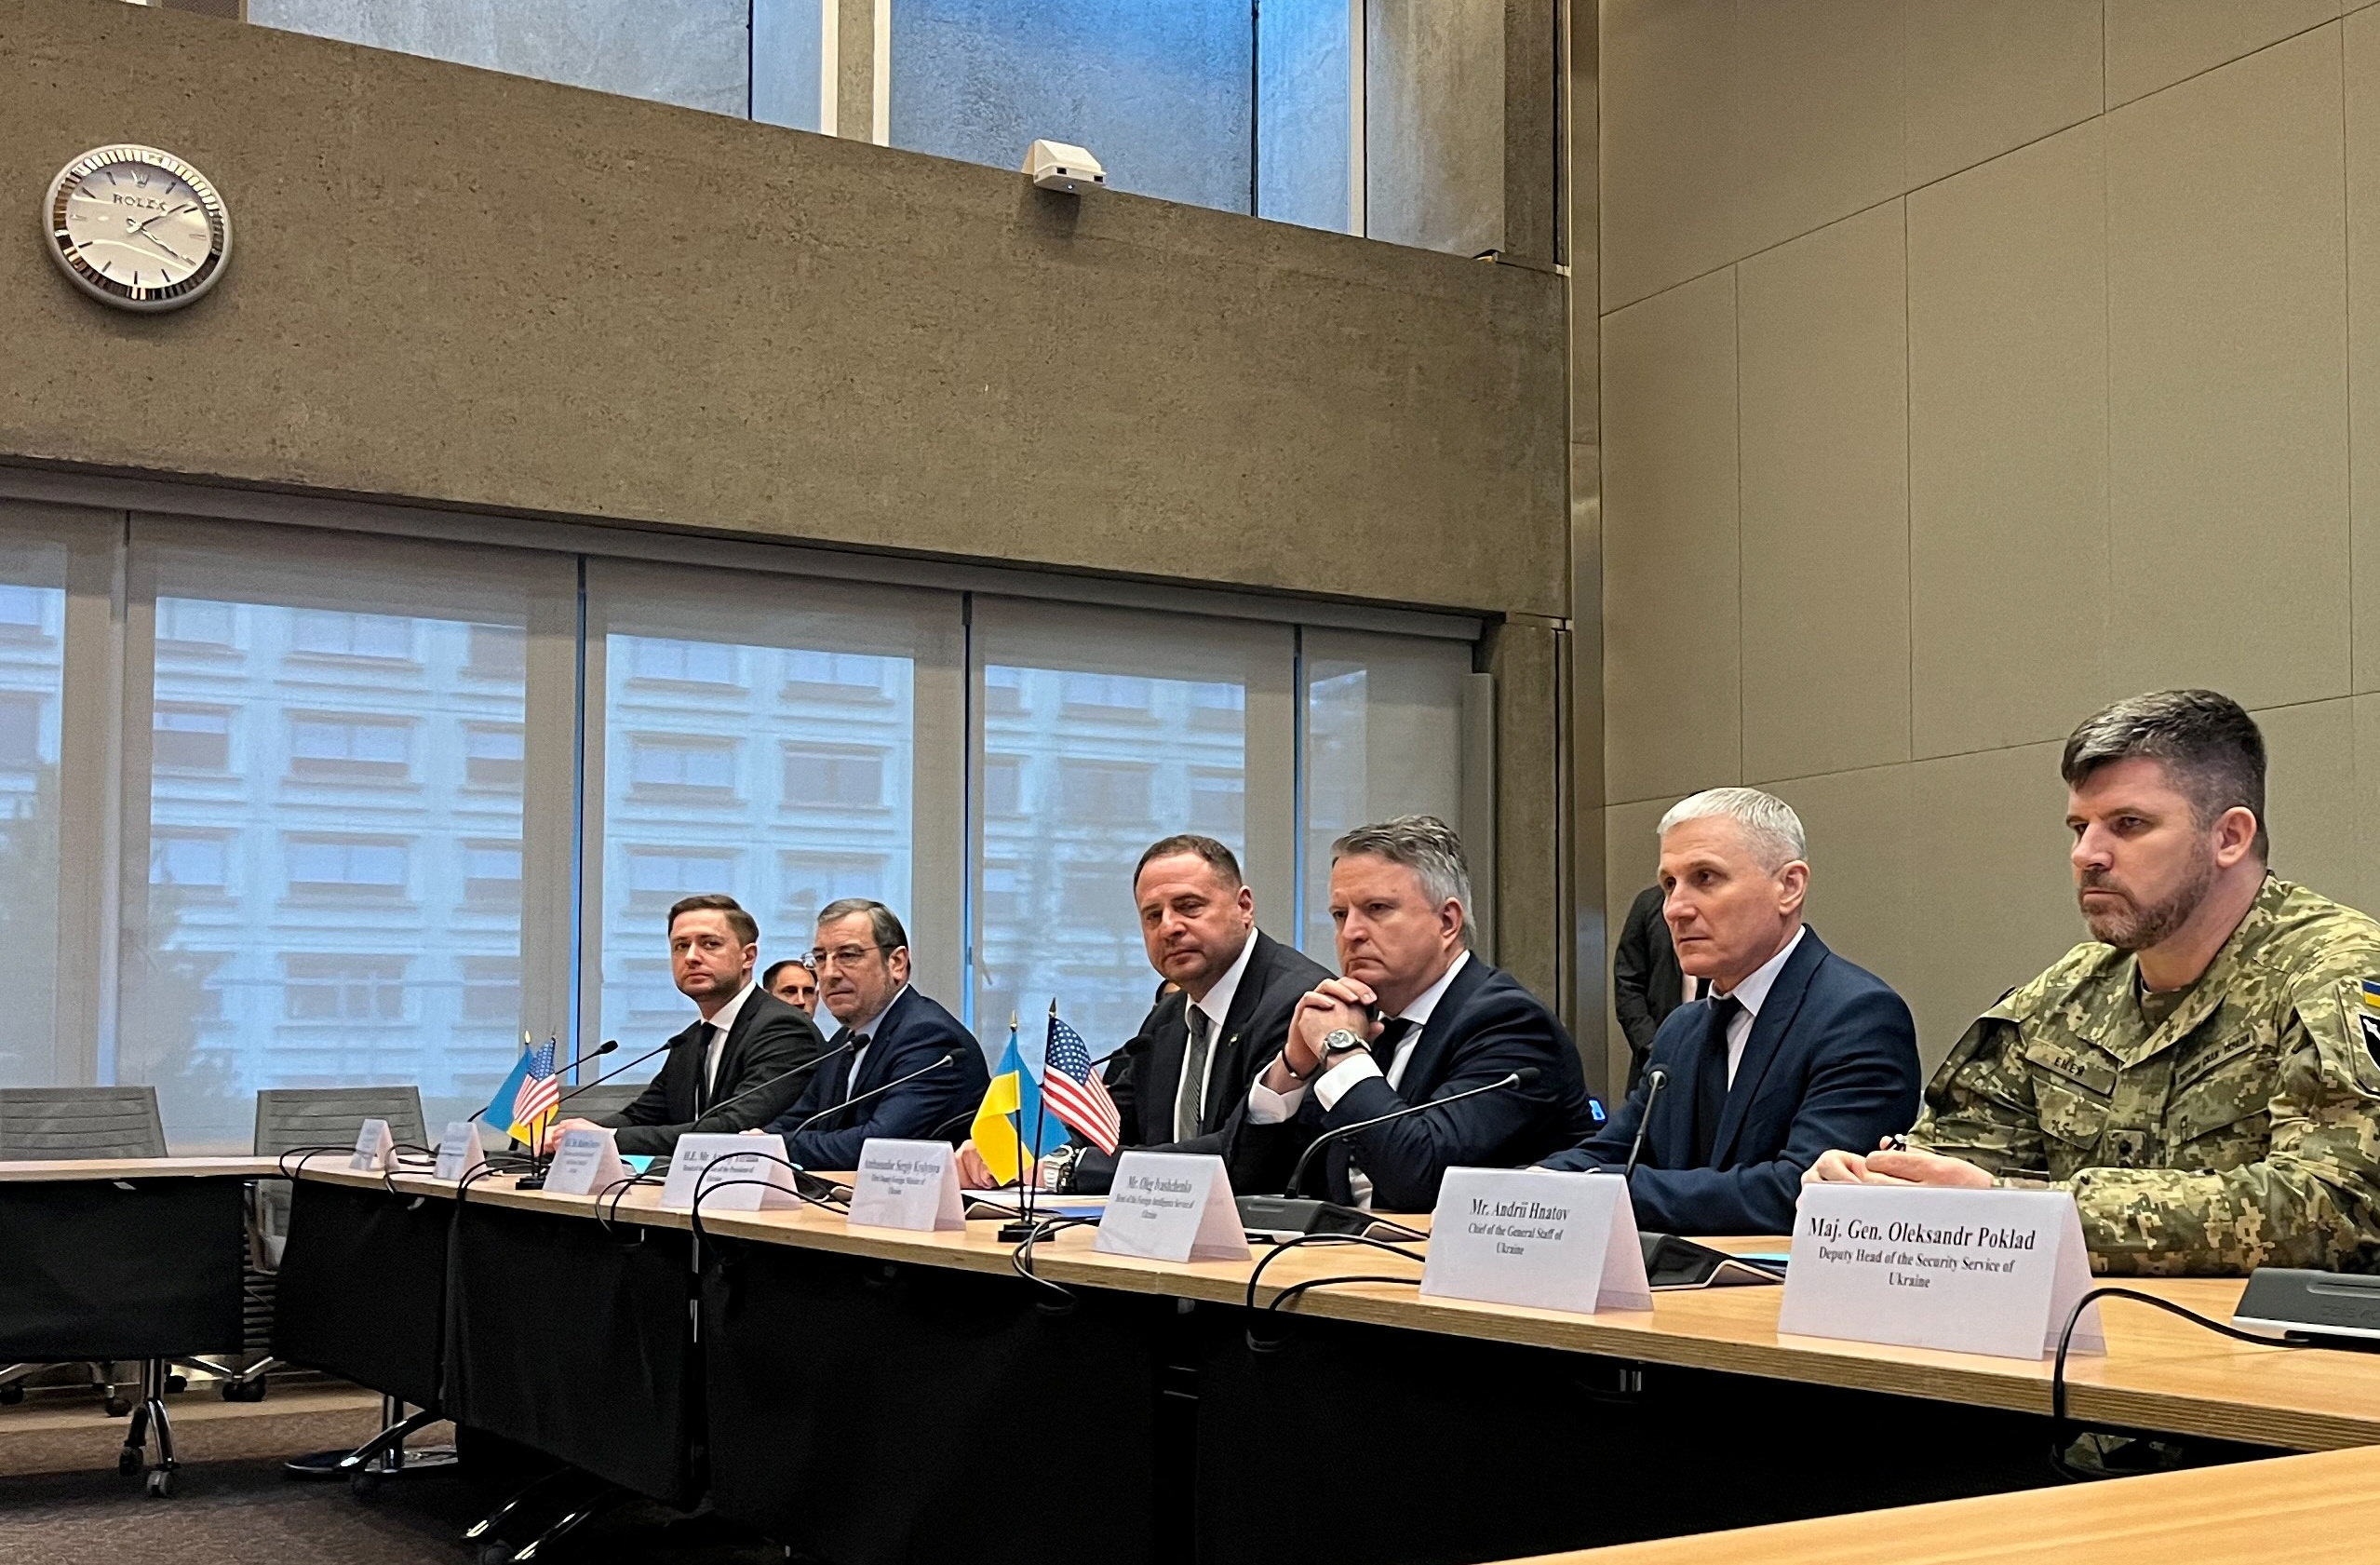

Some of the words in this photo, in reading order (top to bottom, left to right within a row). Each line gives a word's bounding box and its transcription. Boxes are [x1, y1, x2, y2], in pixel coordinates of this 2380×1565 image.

[113, 193, 167, 212] ROLEX
[1470, 1198, 1489, 1216] Mr.
[1494, 1201, 1528, 1219] Andrii
[1529, 1202, 1570, 1221] Hnatov
[1469, 1222, 1486, 1234] Chief
[1486, 1224, 1495, 1235] of
[1495, 1224, 1506, 1236] the
[1507, 1225, 1535, 1239] General
[1536, 1227, 1554, 1239] Staff
[1554, 1229, 1564, 1240] of
[1809, 1218, 1842, 1242] Maj.
[1848, 1219, 1882, 1241] Gen.
[1889, 1221, 1973, 1247] Oleksandr
[1978, 1227, 2036, 1250] Poklad
[1819, 1247, 1853, 1263] Deputy
[1856, 1248, 1882, 1263] Head
[1884, 1250, 1896, 1264] of
[1897, 1251, 1914, 1266] the
[1916, 1253, 1958, 1271] Security
[1961, 1257, 2000, 1272] Service
[2002, 1259, 2016, 1273] of
[1889, 1272, 1930, 1288] Ukraine
